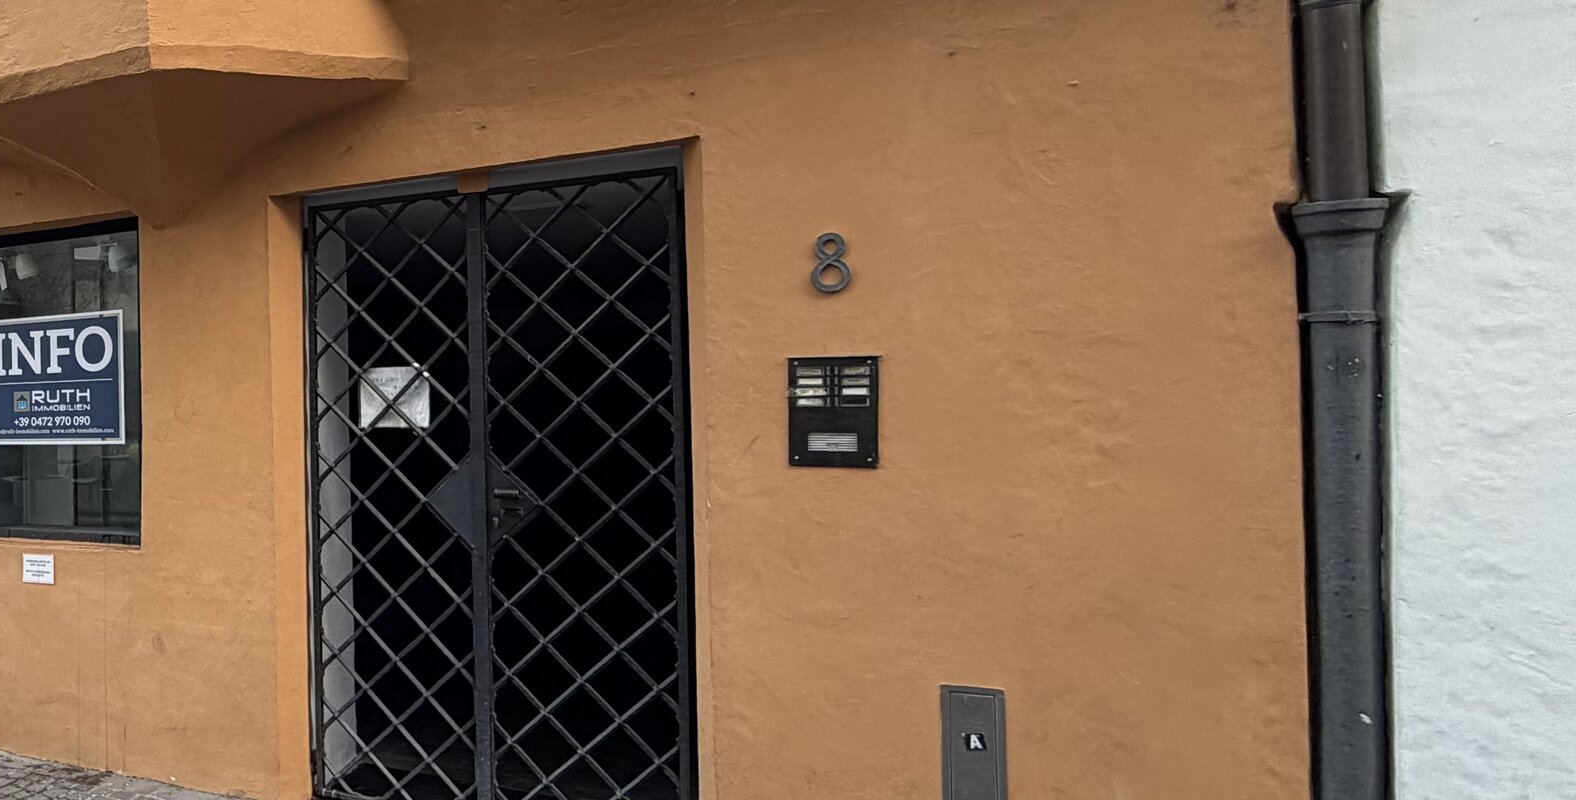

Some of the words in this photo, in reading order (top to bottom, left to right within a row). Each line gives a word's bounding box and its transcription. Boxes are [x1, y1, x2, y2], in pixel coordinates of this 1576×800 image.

[810, 232, 851, 293] 8
[31, 388, 91, 404] RUTH
[31, 403, 91, 412] IMMOBILIEN
[13, 417, 29, 427] +39
[31, 416, 53, 427] 0472
[55, 415, 72, 426] 970
[73, 415, 91, 426] 090
[969, 734, 984, 750] A
